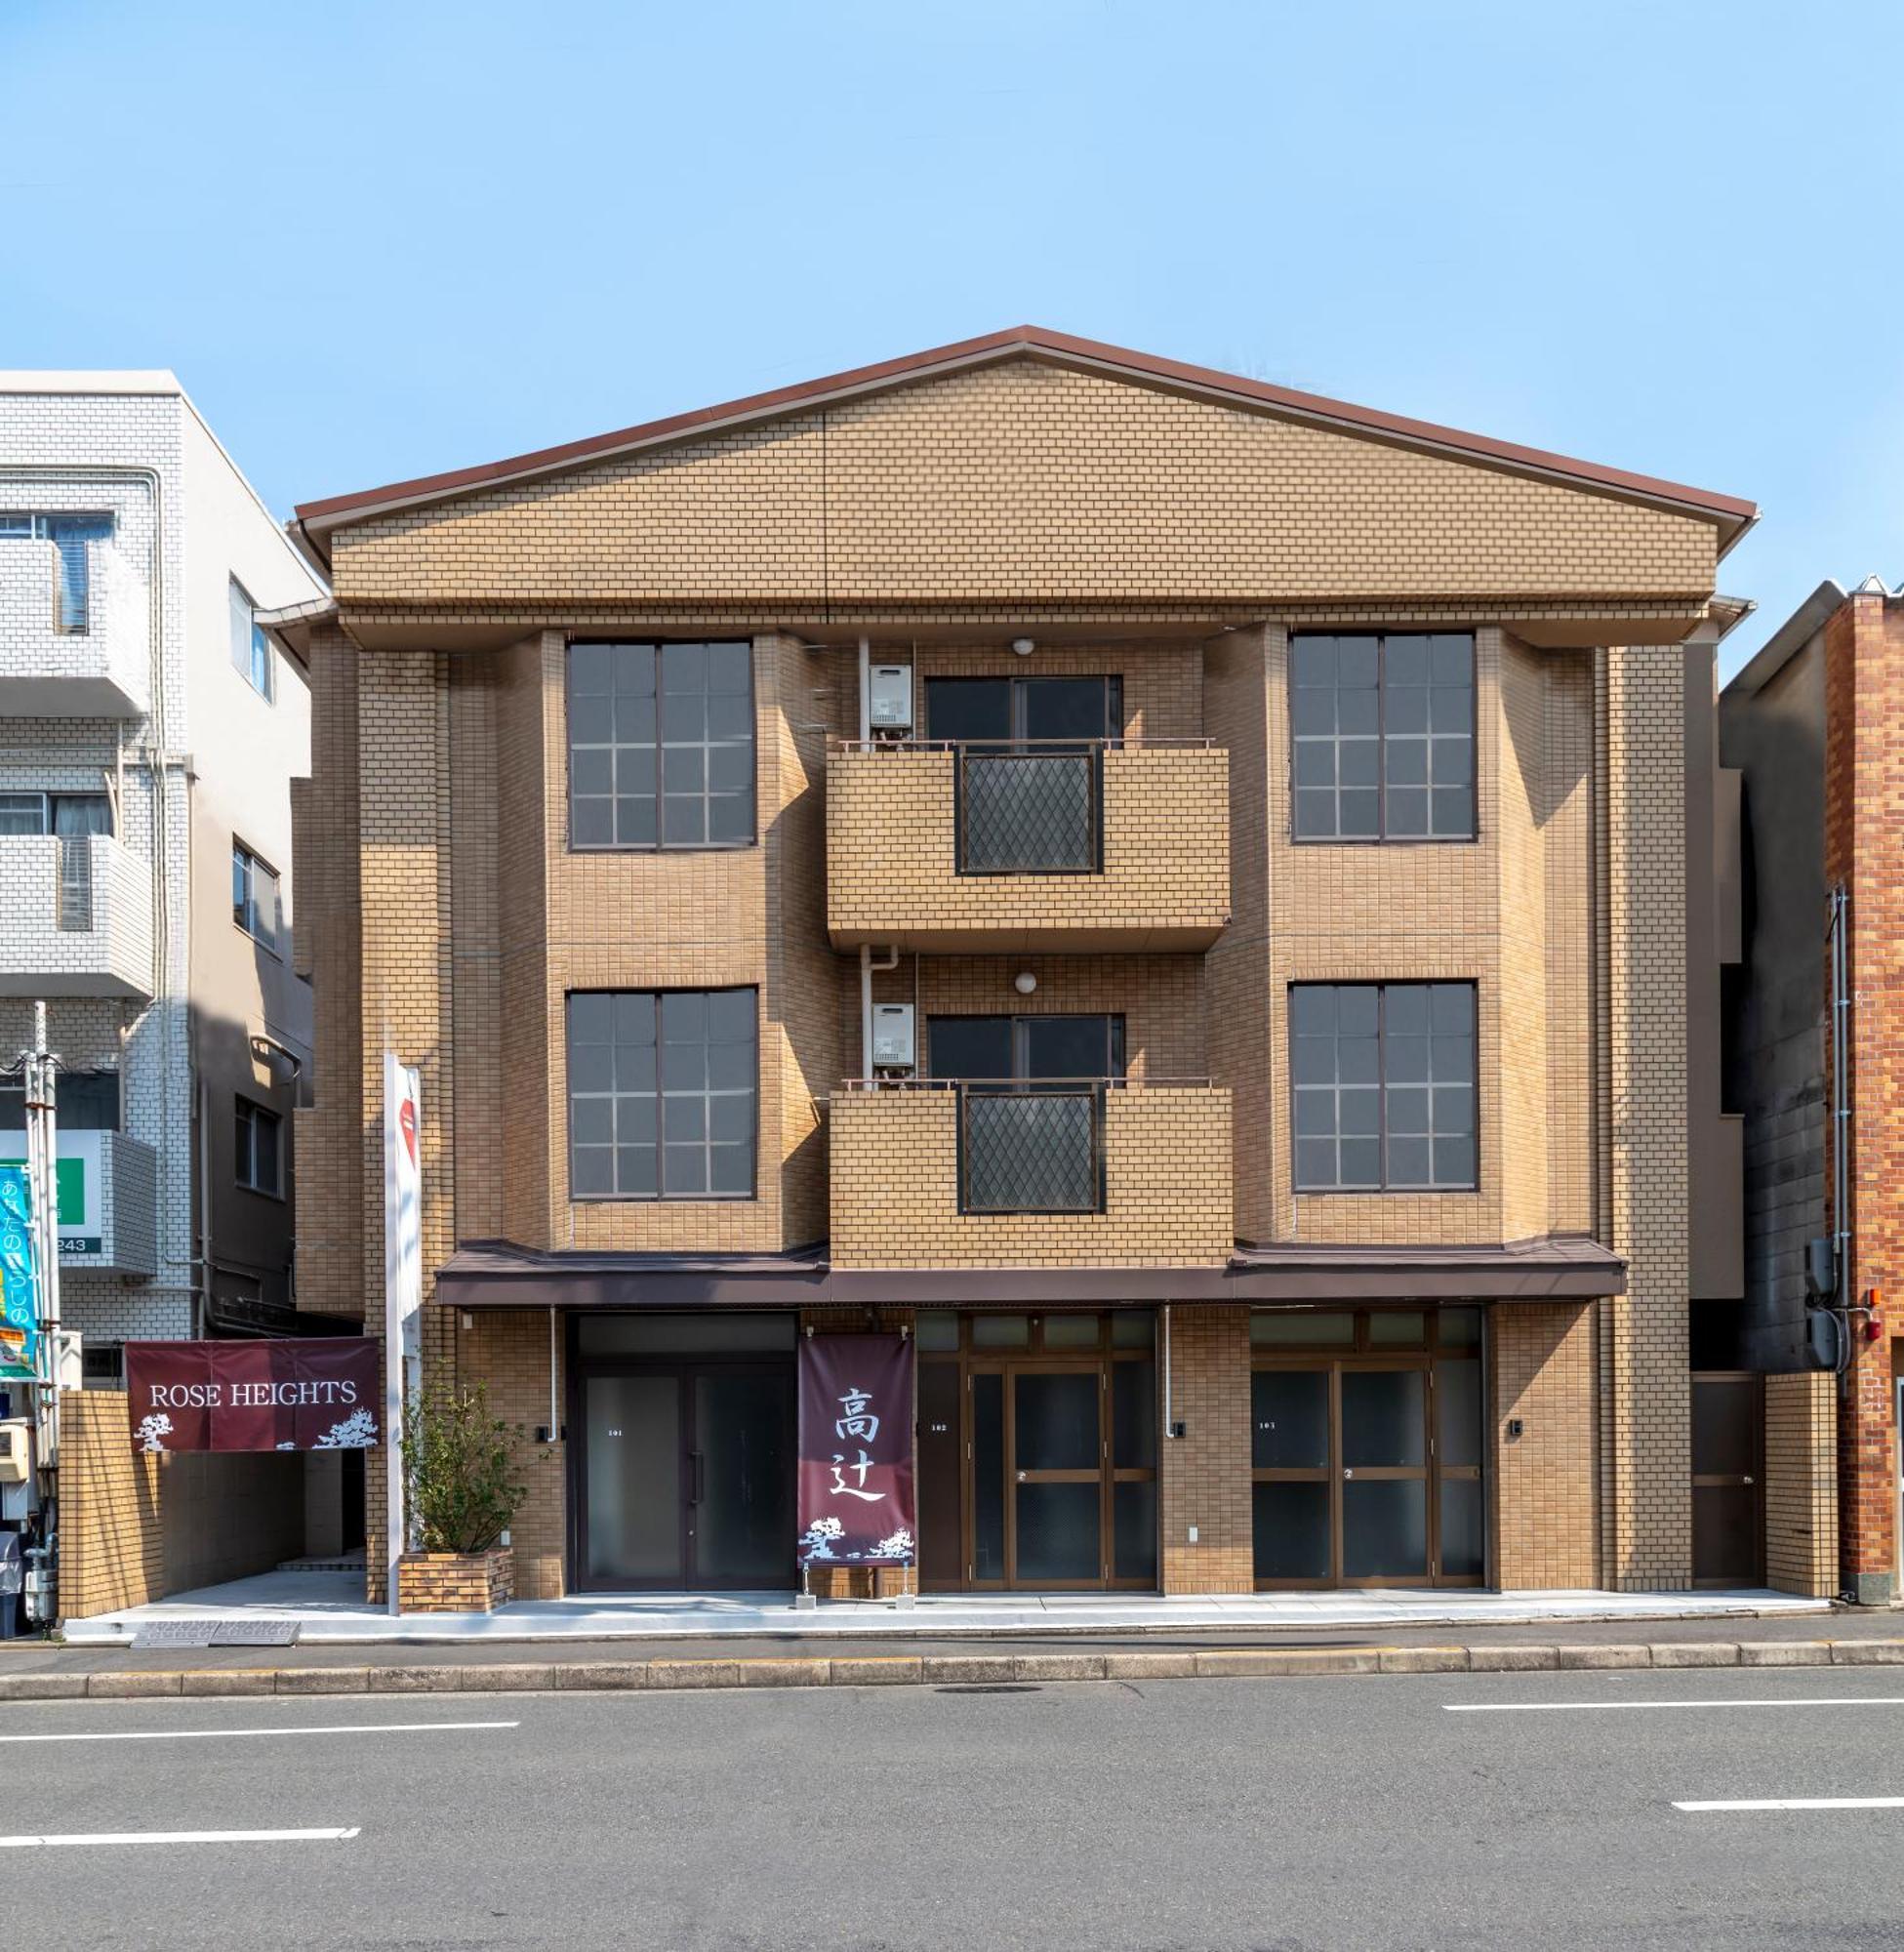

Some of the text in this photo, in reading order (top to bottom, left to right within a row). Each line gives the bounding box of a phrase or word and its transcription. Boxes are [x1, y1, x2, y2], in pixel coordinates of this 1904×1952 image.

[149, 1380, 357, 1407] ROSE HEIGHTS
[830, 1387, 886, 1502] 高辻
